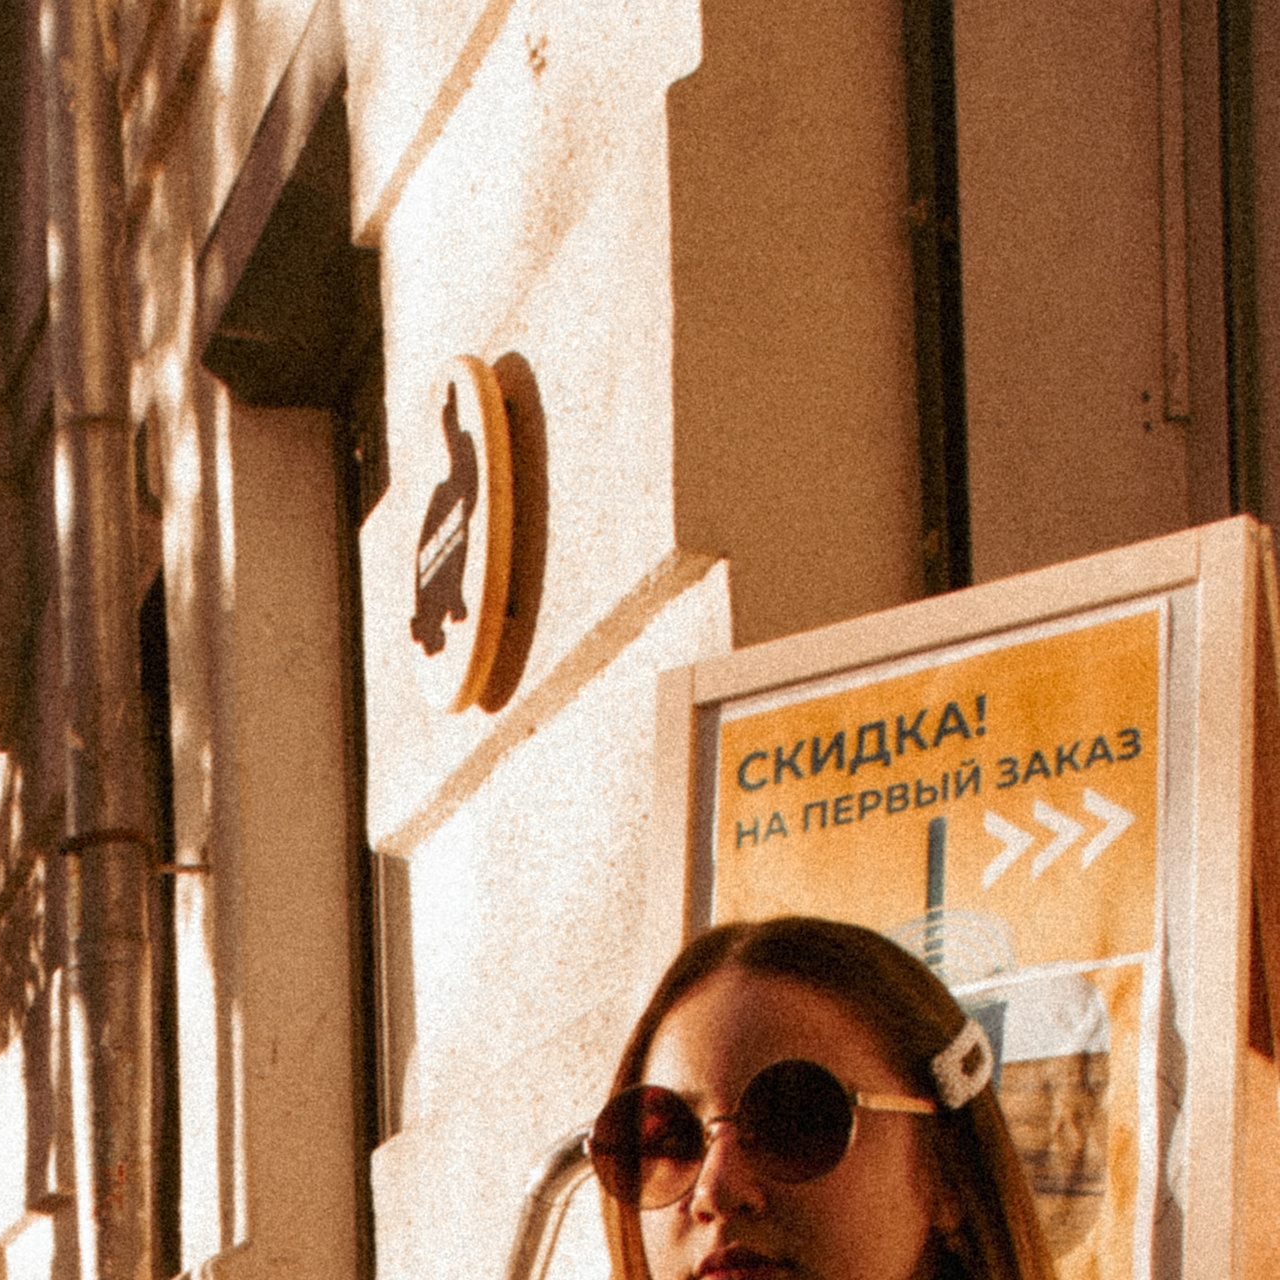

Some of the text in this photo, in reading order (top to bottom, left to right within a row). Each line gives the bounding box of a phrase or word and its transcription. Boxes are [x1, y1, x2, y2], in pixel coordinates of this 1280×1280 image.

[734, 727, 1142, 849] НА ПЕРВЫЙ ЗАКАЗ
[736, 694, 988, 791] СКИДКА!
